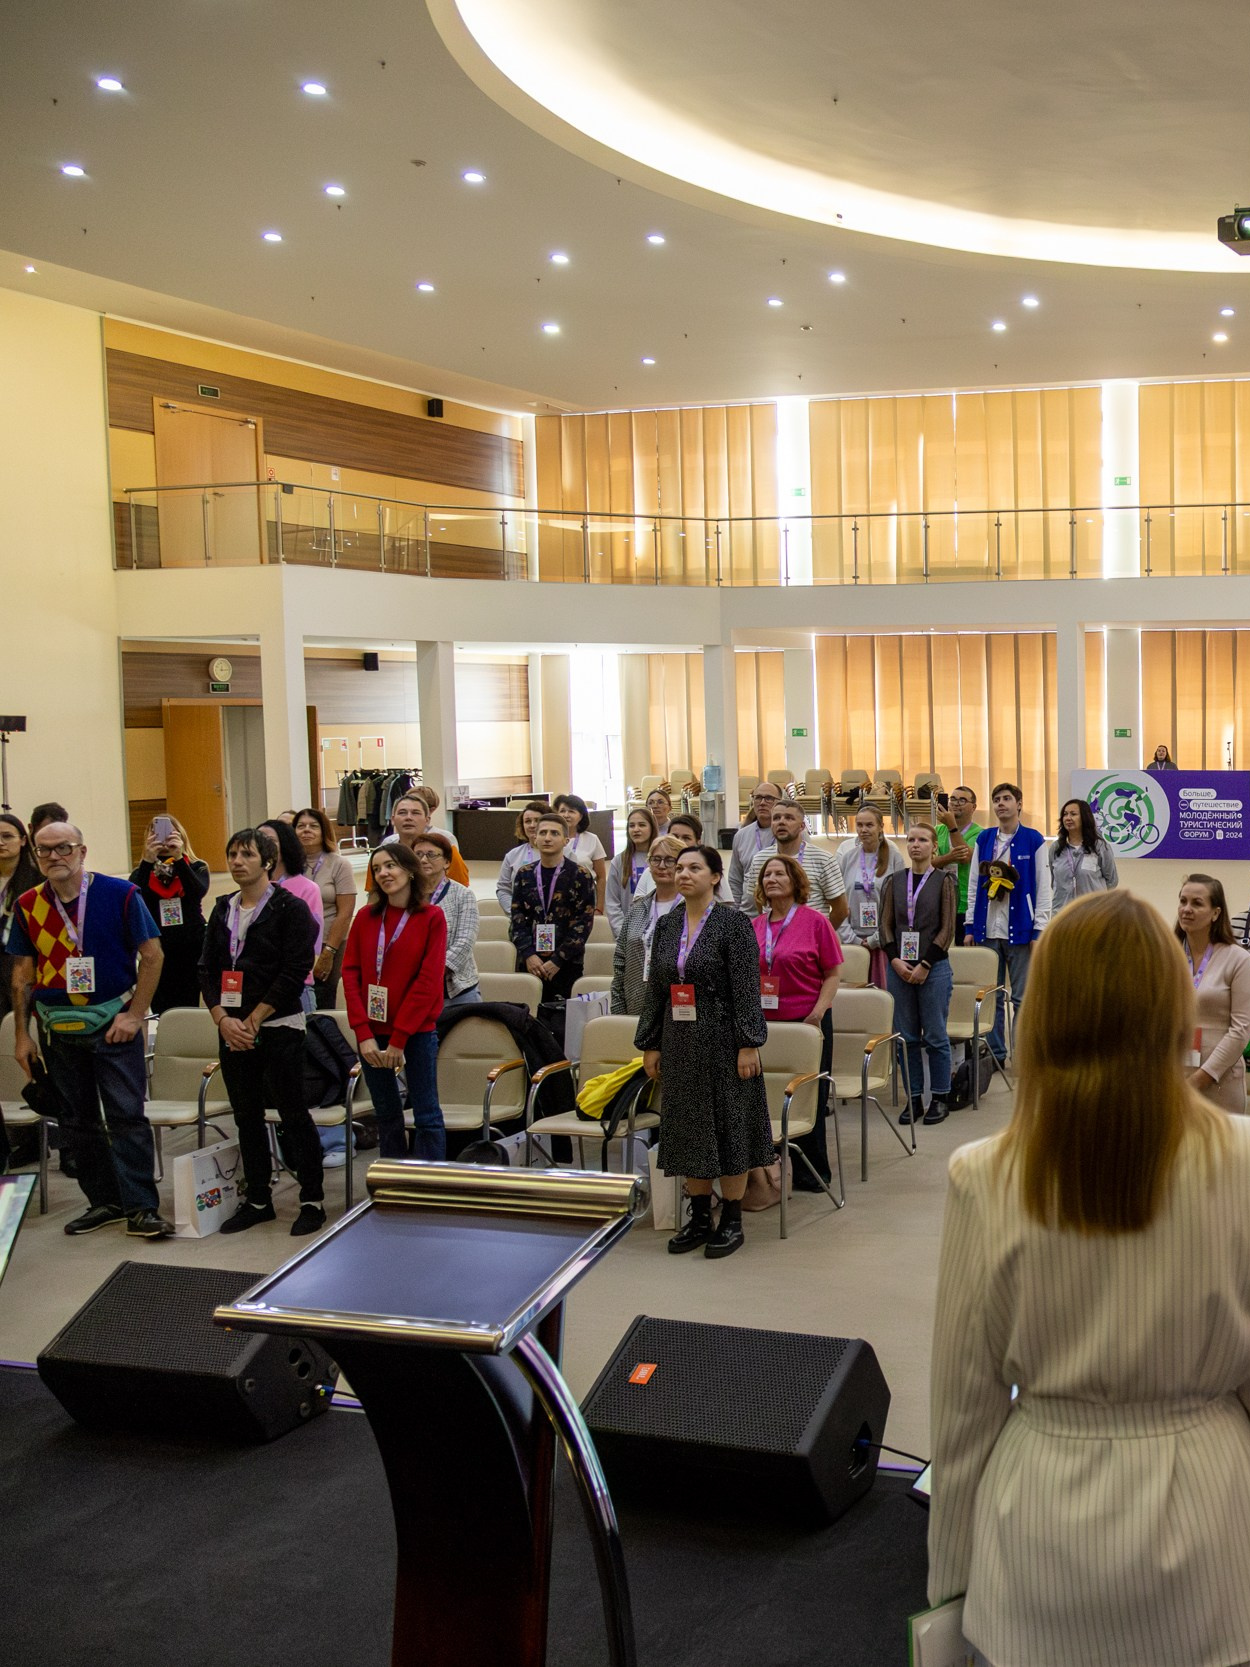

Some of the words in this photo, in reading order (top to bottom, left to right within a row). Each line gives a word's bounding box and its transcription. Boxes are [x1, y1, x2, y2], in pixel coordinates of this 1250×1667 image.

[1182, 789, 1214, 798] Больше,
[1192, 801, 1240, 809] путешествие
[1179, 811, 1237, 820] МОЛОДЁЖНЫЙ
[1179, 820, 1243, 829] ТУРИСТИЧЕСКИЙ
